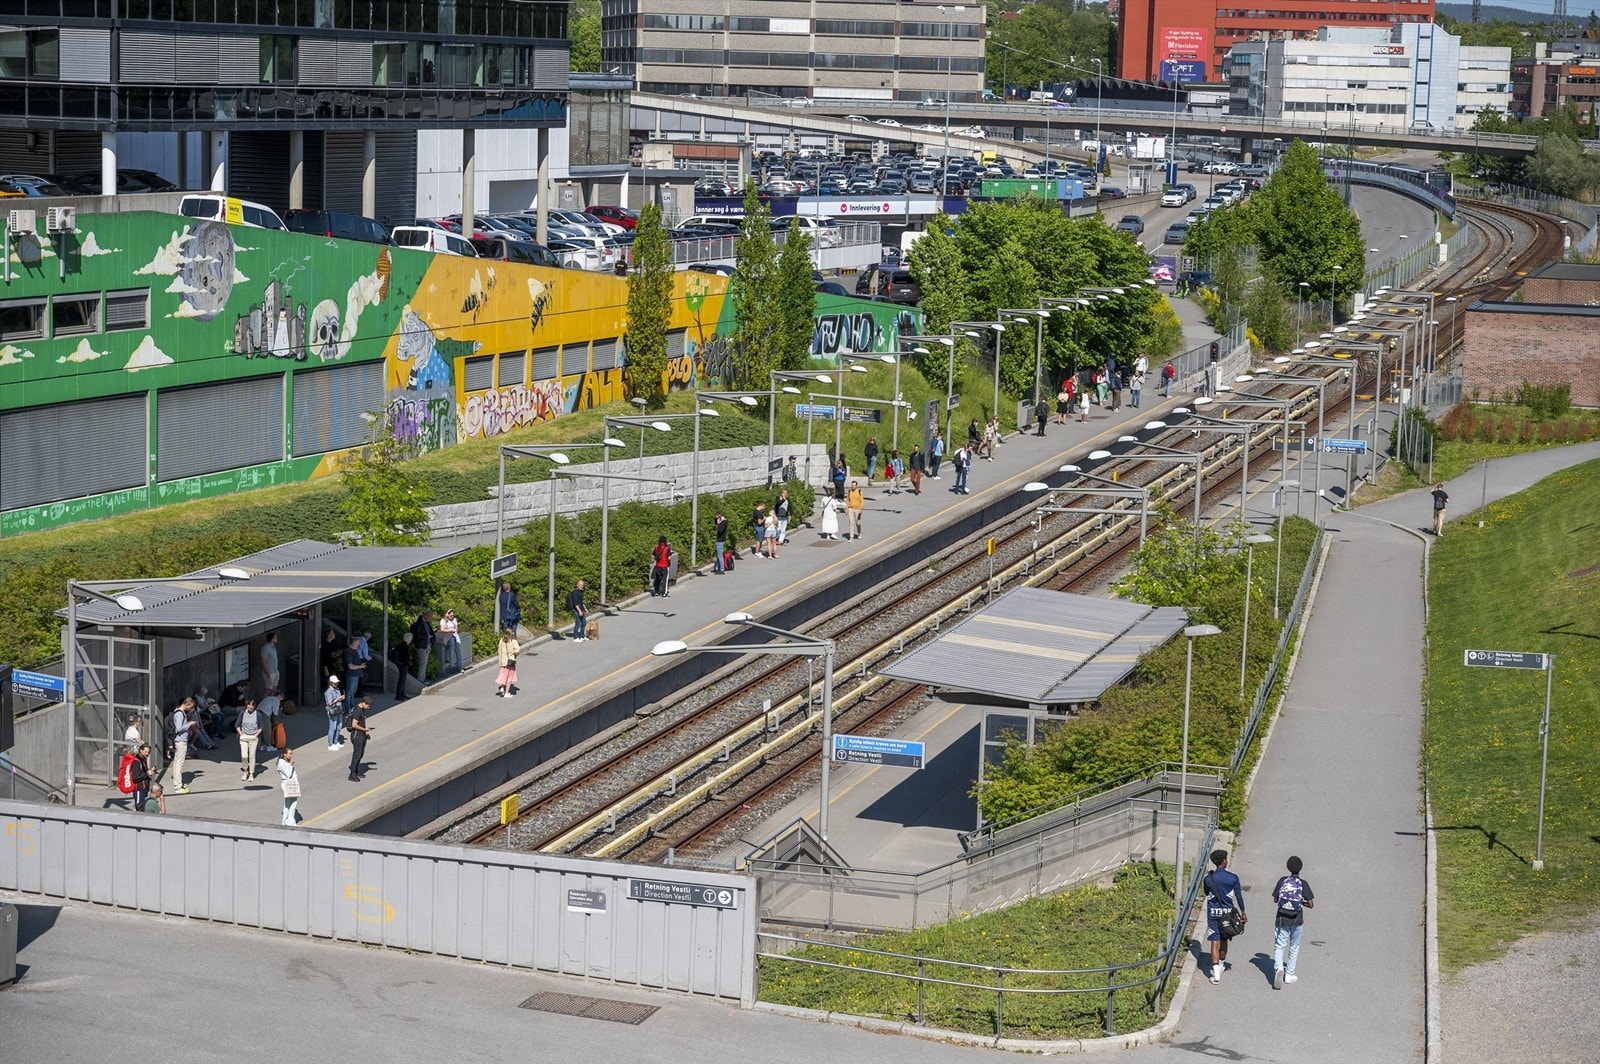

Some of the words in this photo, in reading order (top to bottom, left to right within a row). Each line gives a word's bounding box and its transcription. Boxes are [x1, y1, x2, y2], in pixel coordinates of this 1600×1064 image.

[849, 204, 881, 213] Innlevering
[644, 882, 670, 892] Retning
[672, 885, 691, 893] Vestli
[644, 890, 672, 899] Direction
[673, 893, 691, 901] Vestli
